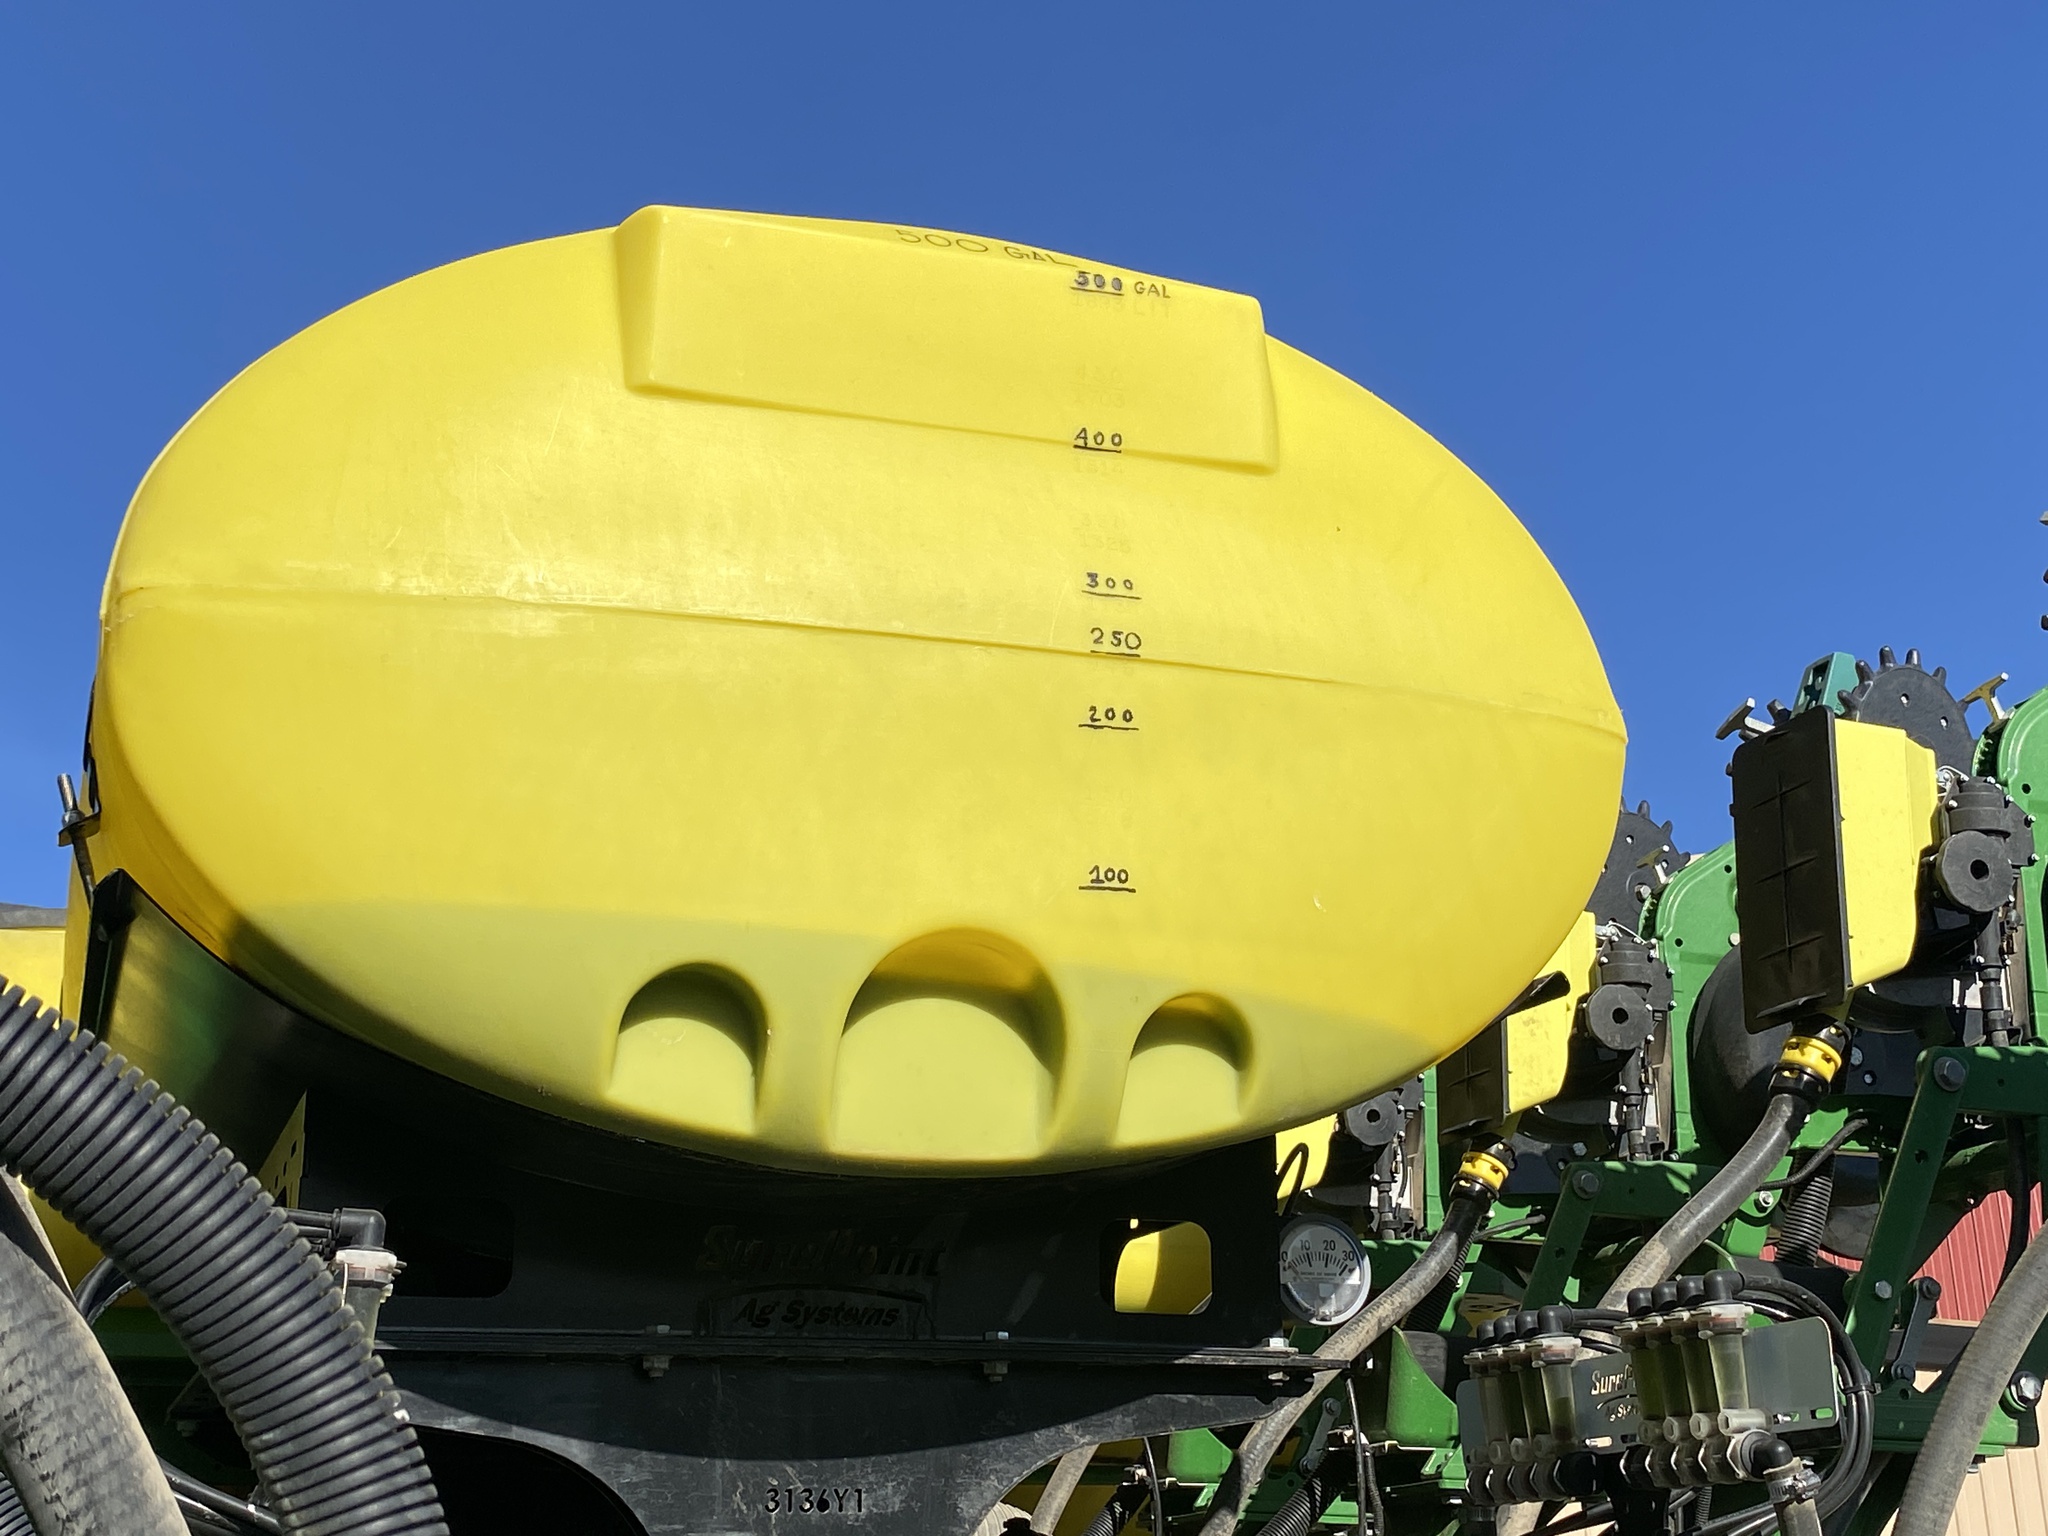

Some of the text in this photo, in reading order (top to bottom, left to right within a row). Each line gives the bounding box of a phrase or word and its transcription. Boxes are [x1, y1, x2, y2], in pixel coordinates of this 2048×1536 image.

[896, 228, 1078, 268] 500 GAL
[1073, 270, 1172, 299] 500 GAL
[1073, 427, 1123, 447] 400
[1085, 571, 1134, 592] 300
[1090, 627, 1142, 651] 250
[1088, 705, 1134, 723] 200
[1088, 864, 1130, 885] 100
[1300, 1239, 1311, 1251] 10
[1322, 1239, 1336, 1251] 20
[1342, 1250, 1355, 1262] 30
[733, 1297, 901, 1330] Ag Systems
[764, 1488, 863, 1514] 3136Y1
